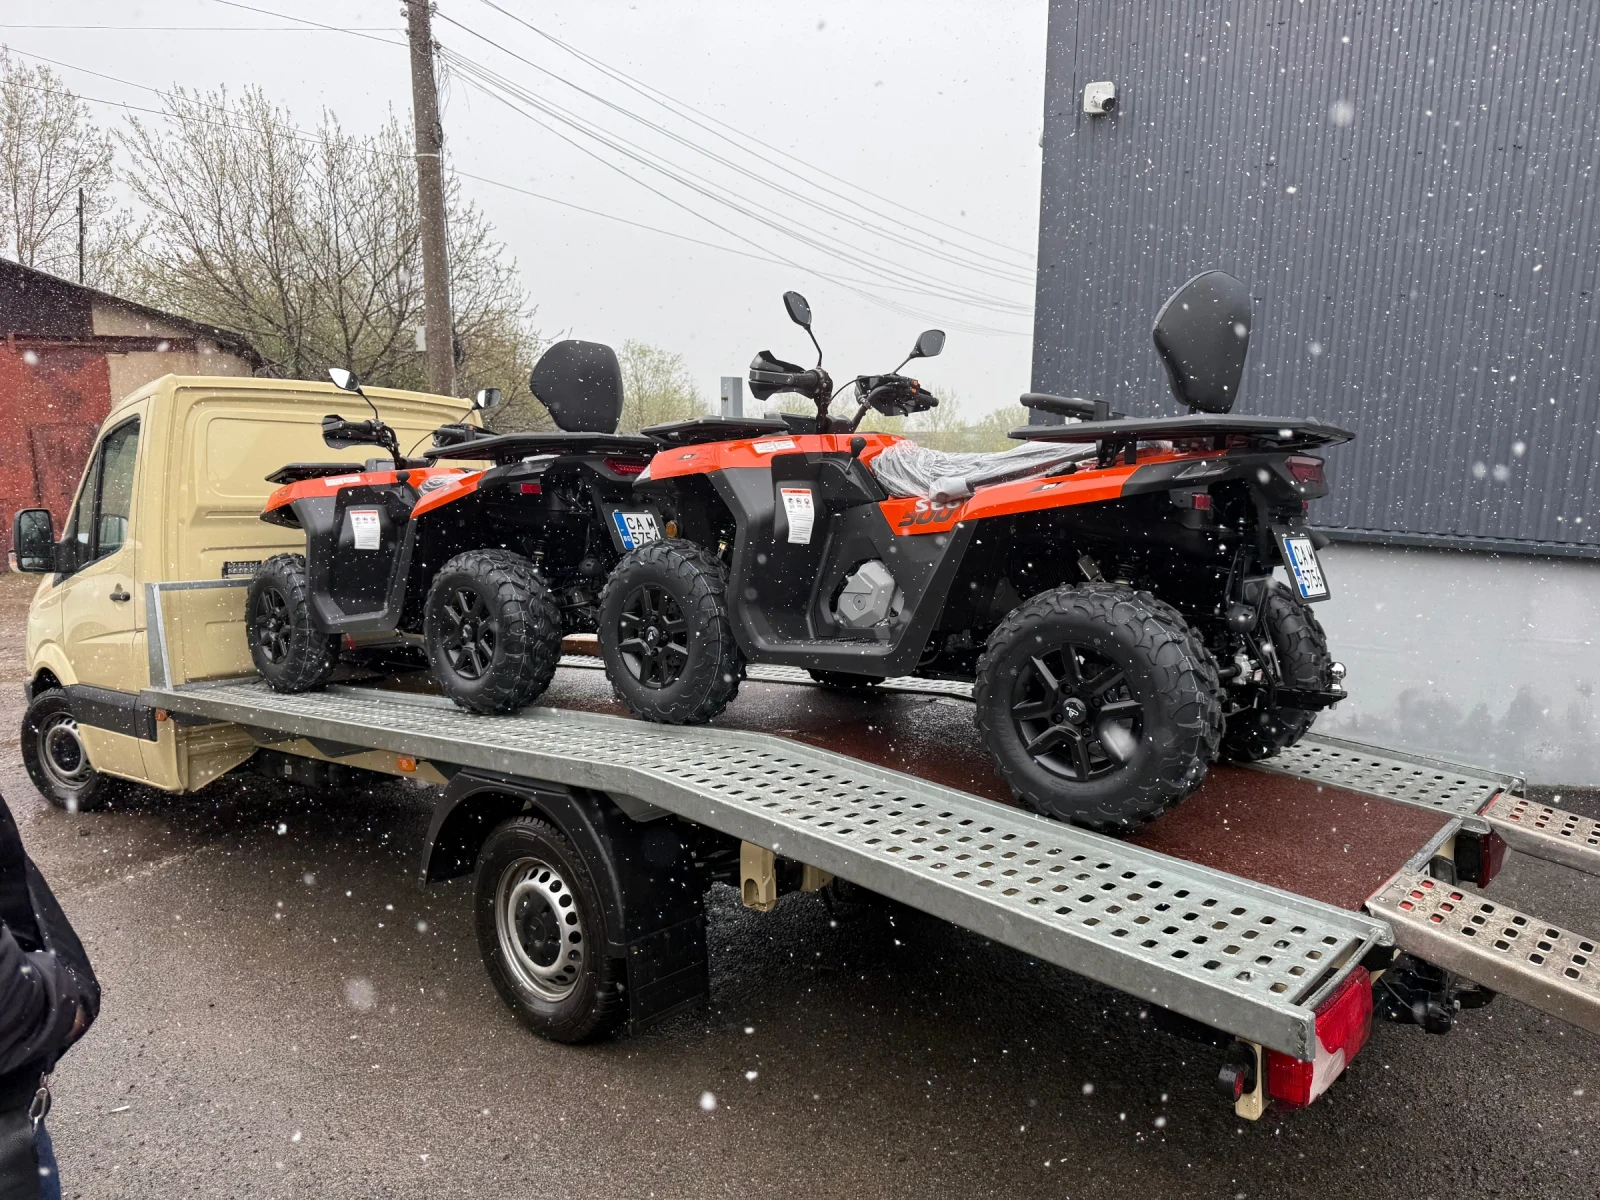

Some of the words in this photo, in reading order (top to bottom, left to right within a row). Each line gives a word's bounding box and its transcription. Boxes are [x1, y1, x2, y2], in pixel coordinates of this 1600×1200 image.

[626, 517, 645, 530] CA
[646, 517, 656, 530] M
[1294, 546, 1310, 565] CA
[1306, 545, 1317, 565] M
